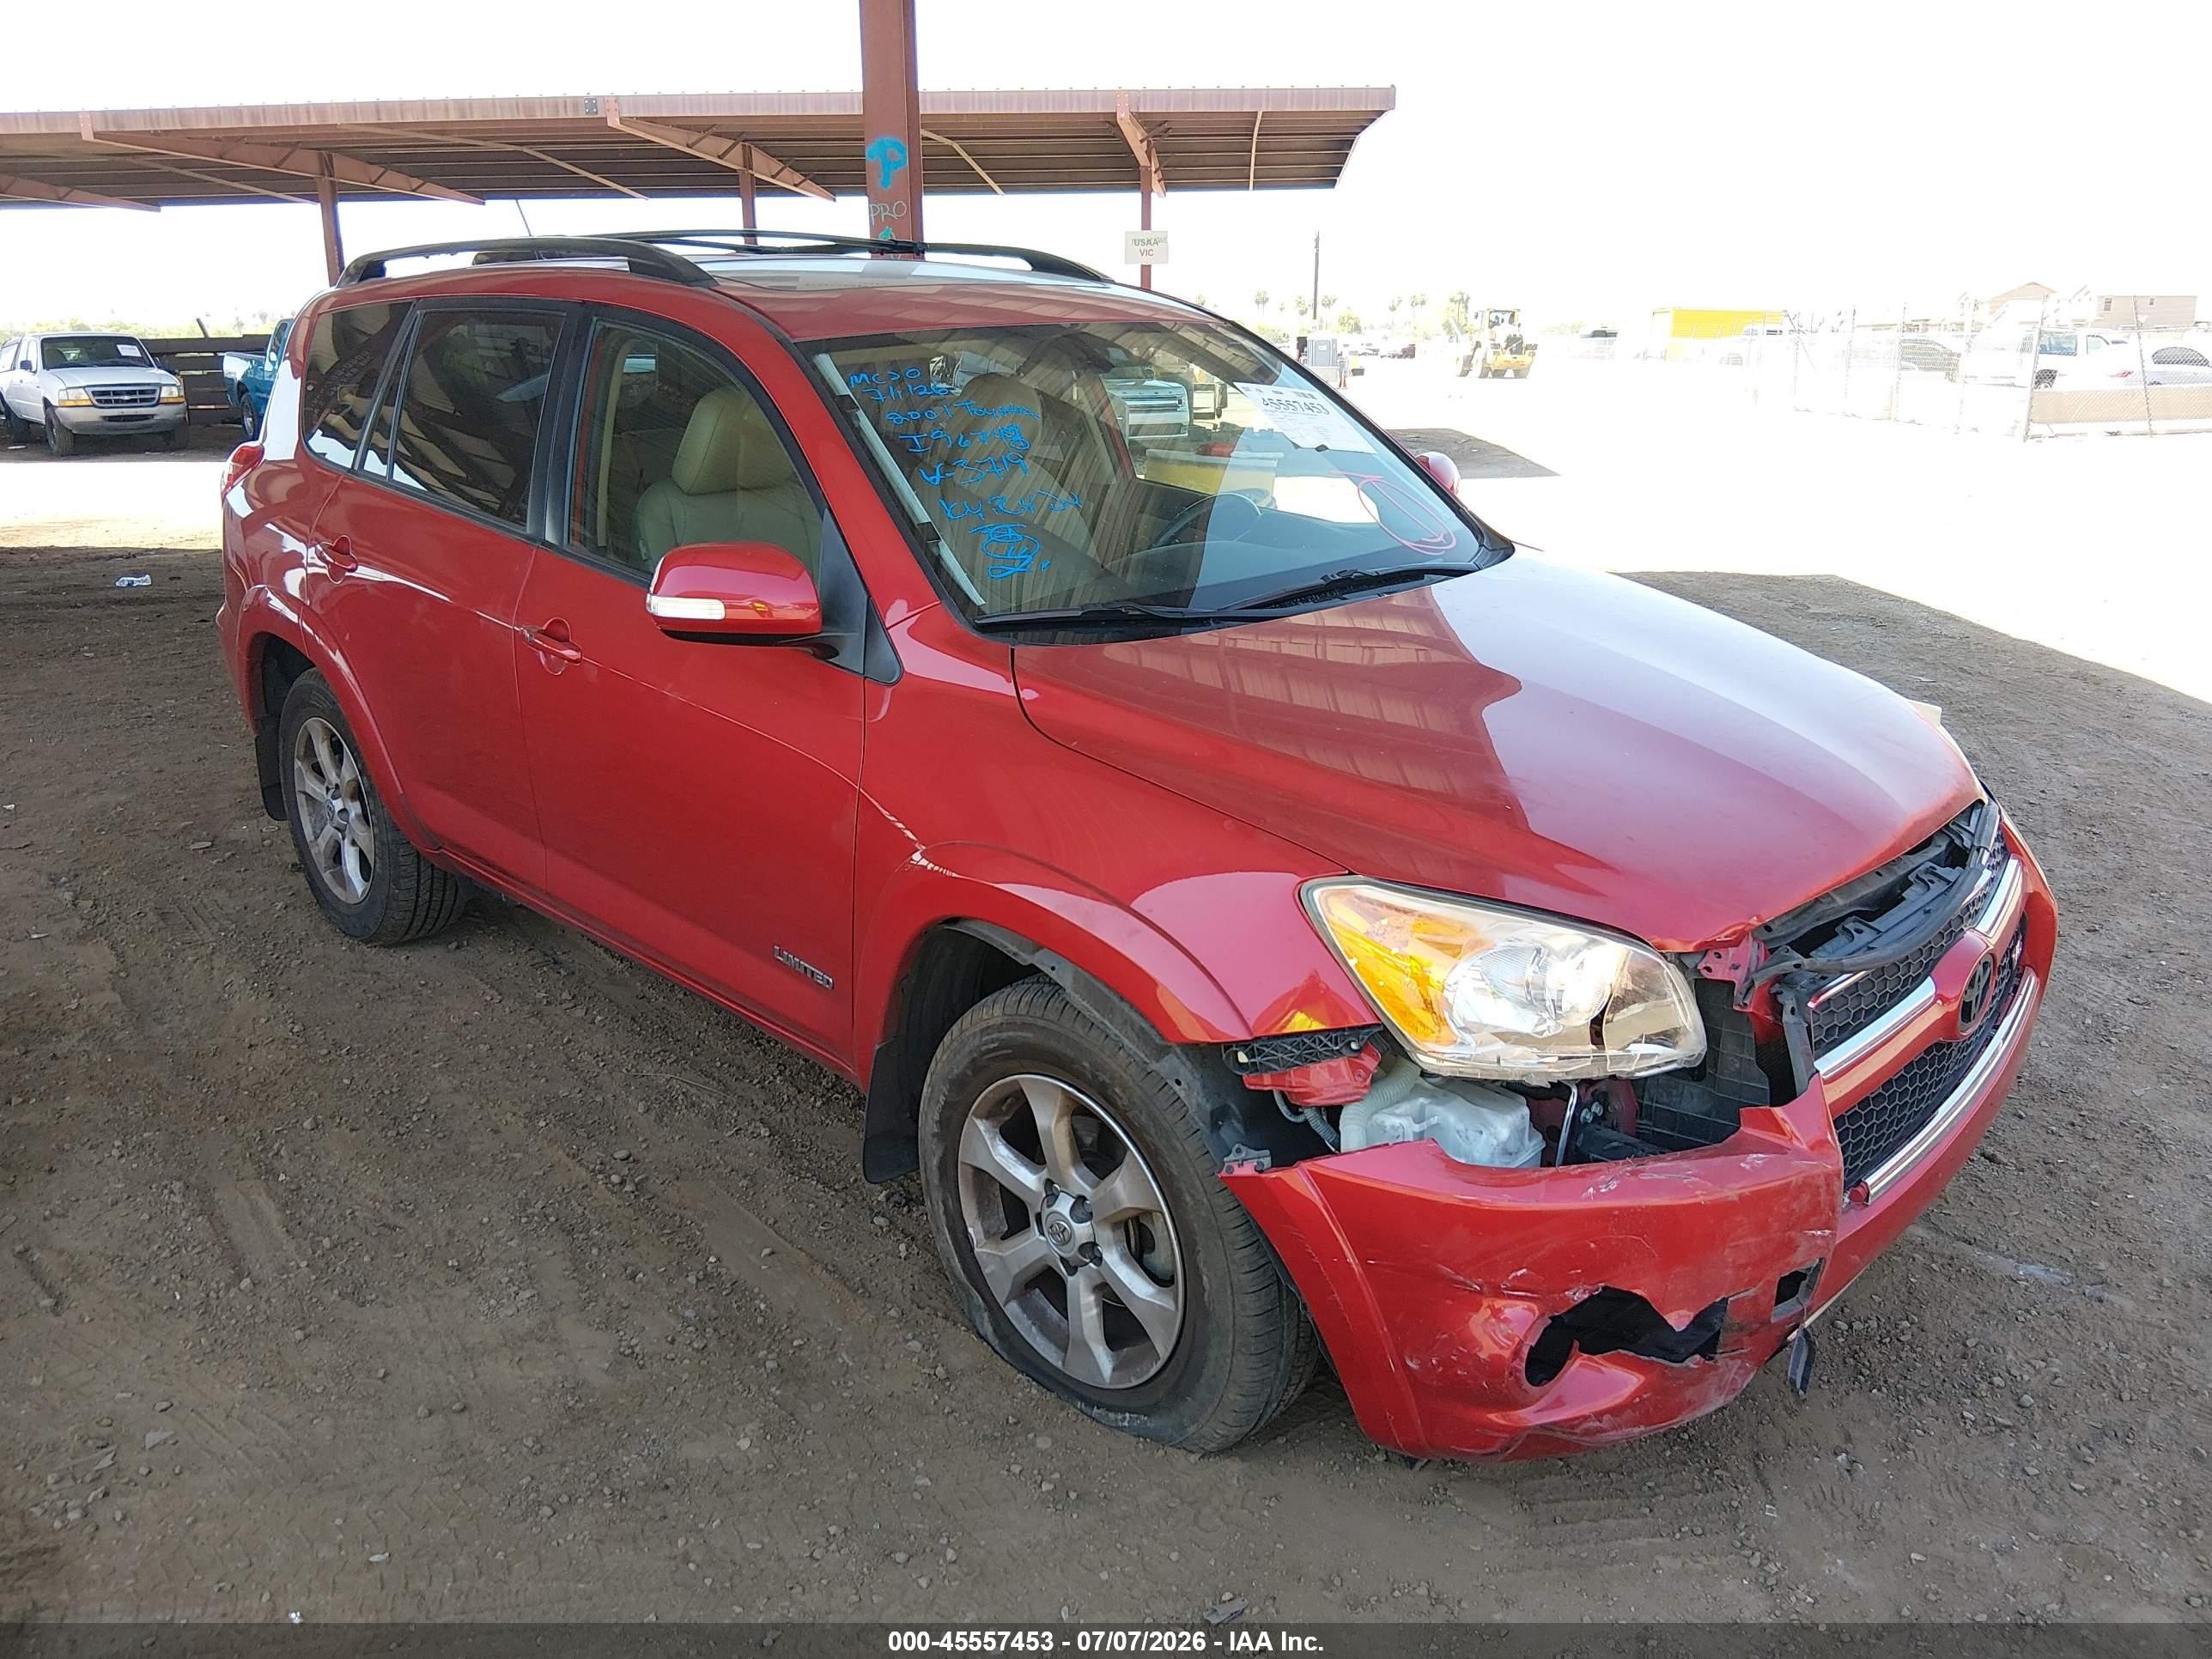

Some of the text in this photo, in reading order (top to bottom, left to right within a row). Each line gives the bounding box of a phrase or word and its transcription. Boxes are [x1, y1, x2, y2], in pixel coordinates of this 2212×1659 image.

[866, 136, 908, 190] P
[868, 200, 907, 226] PRO
[1139, 248, 1154, 257] VIC
[1261, 398, 1330, 415] 45557453
[774, 945, 833, 989] LIMITED
